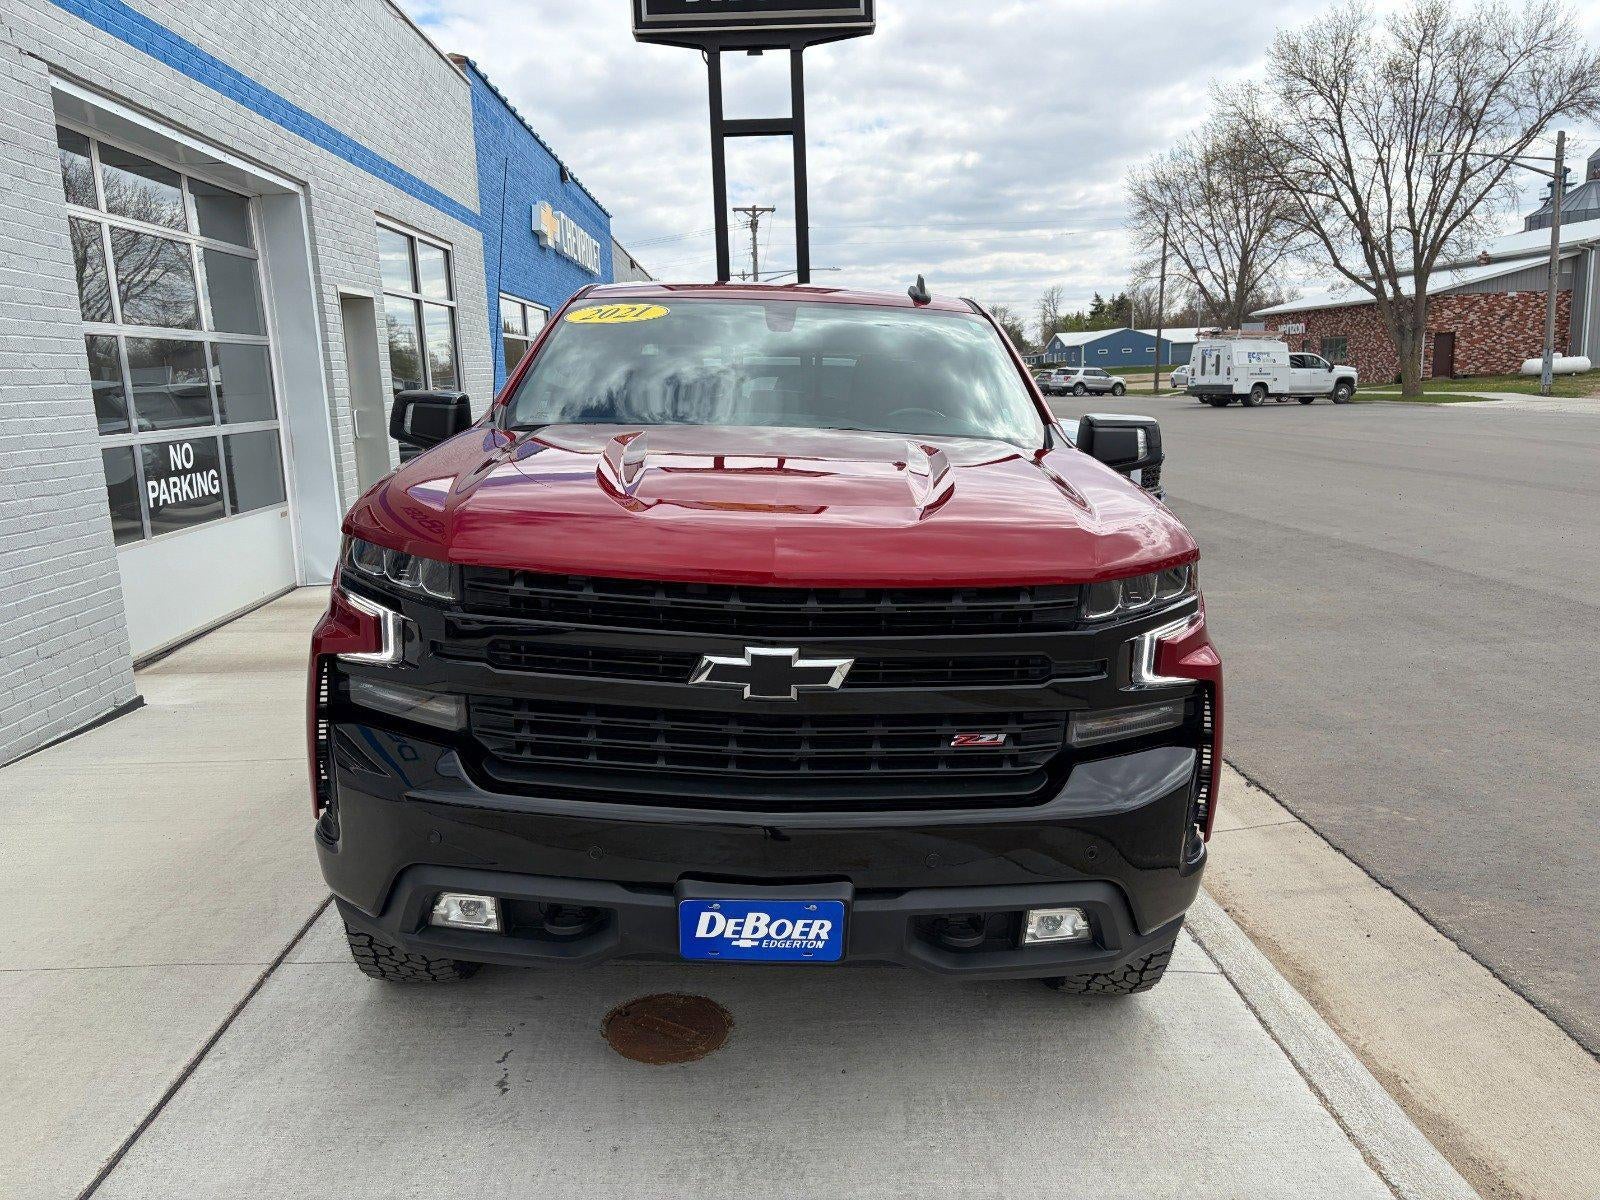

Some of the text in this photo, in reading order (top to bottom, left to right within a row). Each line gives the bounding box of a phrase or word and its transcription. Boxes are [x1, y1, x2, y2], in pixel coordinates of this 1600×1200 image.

[559, 211, 601, 276] CHEVROLET
[579, 306, 652, 320] 2021
[168, 442, 194, 471] NO
[146, 468, 220, 508] PARKING
[950, 733, 1007, 747] Z71
[762, 939, 825, 949] EDGERTON
